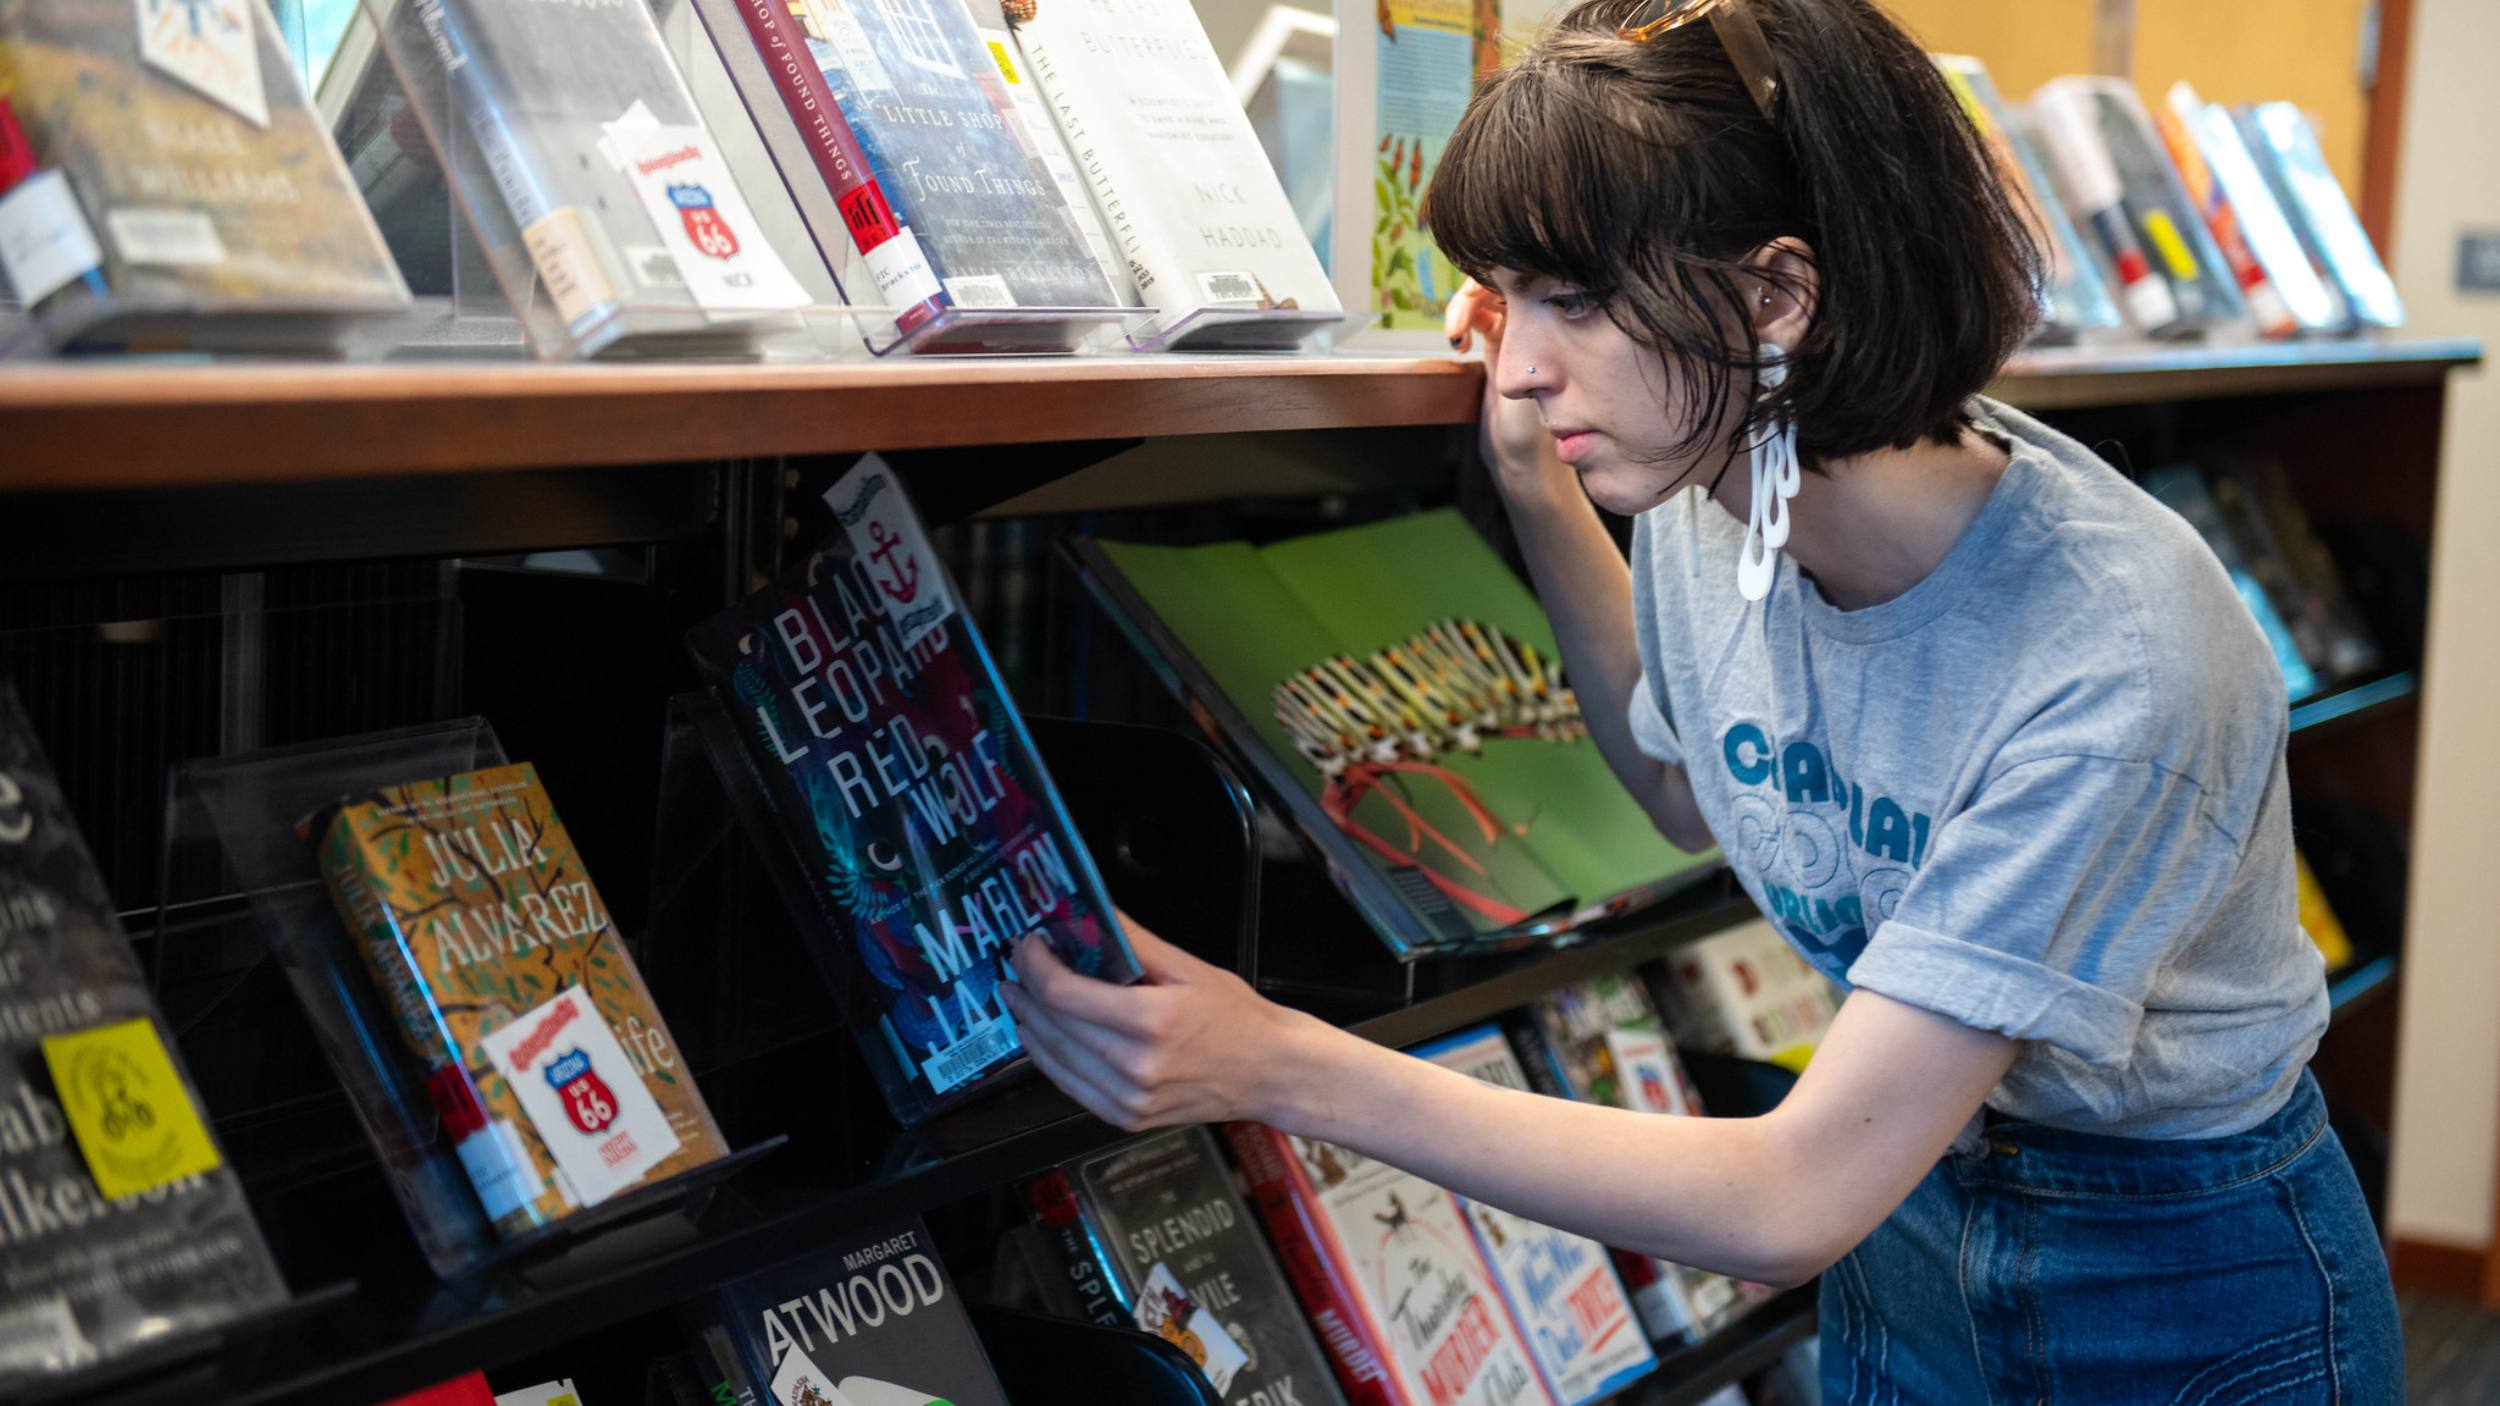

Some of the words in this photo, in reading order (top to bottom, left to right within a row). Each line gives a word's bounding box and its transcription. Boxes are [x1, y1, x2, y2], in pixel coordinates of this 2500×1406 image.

[751, 0, 775, 29] HOP
[770, 35, 786, 48] of
[780, 52, 816, 112] FOUND
[813, 115, 853, 182] THINGS
[883, 105, 953, 127] LITTLE
[958, 111, 1003, 130] SHOP
[1031, 45, 1057, 82] THE
[1054, 92, 1085, 139] LAST
[1082, 148, 1142, 254] BUTTERFLI
[1193, 181, 1247, 206] NICK
[696, 224, 734, 254] 66
[1199, 226, 1283, 249] HADDAD
[774, 554, 887, 677] BLAC
[827, 713, 931, 818] RED
[909, 728, 1008, 846] WOLF
[423, 818, 547, 889] JULIA
[430, 880, 611, 973] ALVAREZ
[914, 831, 1078, 984] MARLON
[614, 1015, 675, 1075] ife
[575, 1089, 614, 1130] 66
[842, 1231, 919, 1272] MARGARET
[1128, 1198, 1236, 1265] SPLENDID
[762, 1253, 944, 1368] ATWOOD
[1069, 1259, 1120, 1329] SPLE
[1189, 1272, 1241, 1311] VILE
